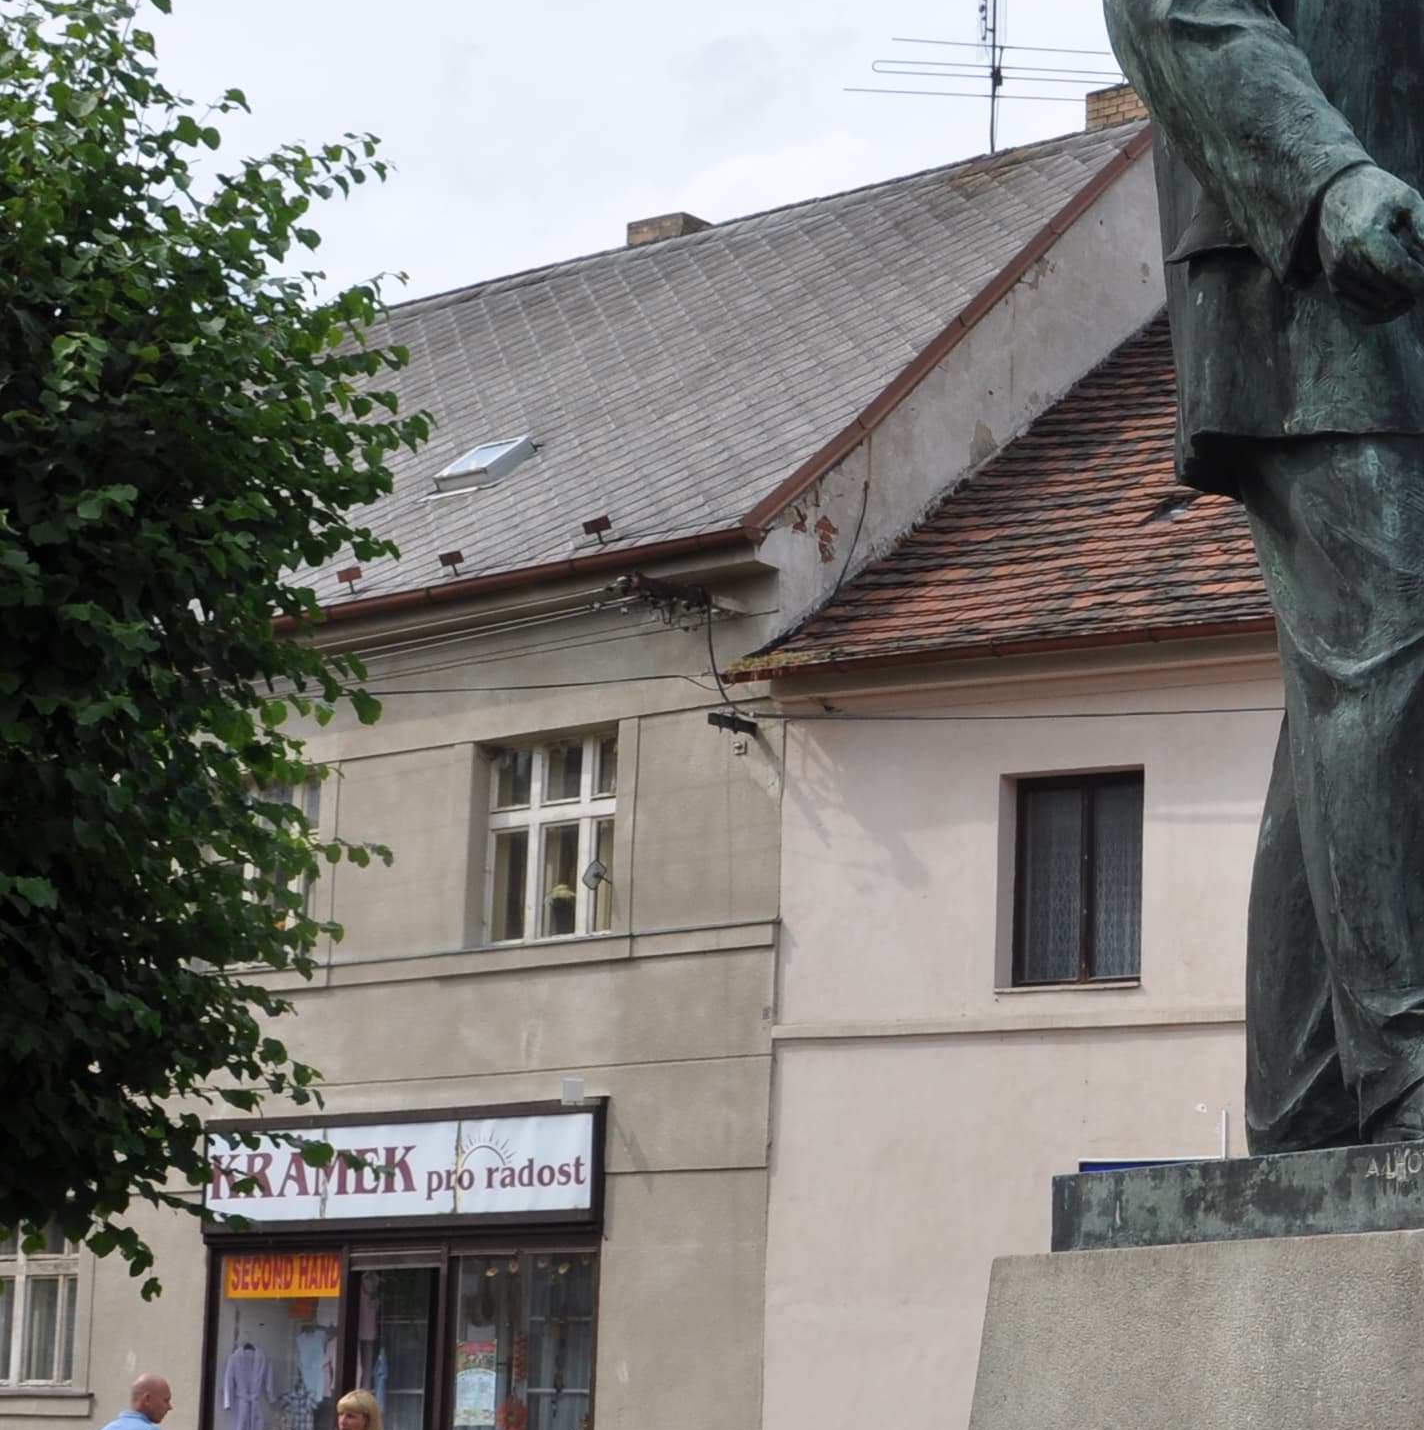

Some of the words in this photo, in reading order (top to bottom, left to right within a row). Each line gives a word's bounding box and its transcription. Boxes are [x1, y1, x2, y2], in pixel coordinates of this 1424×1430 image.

[425, 1168, 475, 1201] pro
[484, 1155, 586, 1189] radost
[231, 1255, 294, 1291] SECOND
[298, 1253, 340, 1290] HAND
